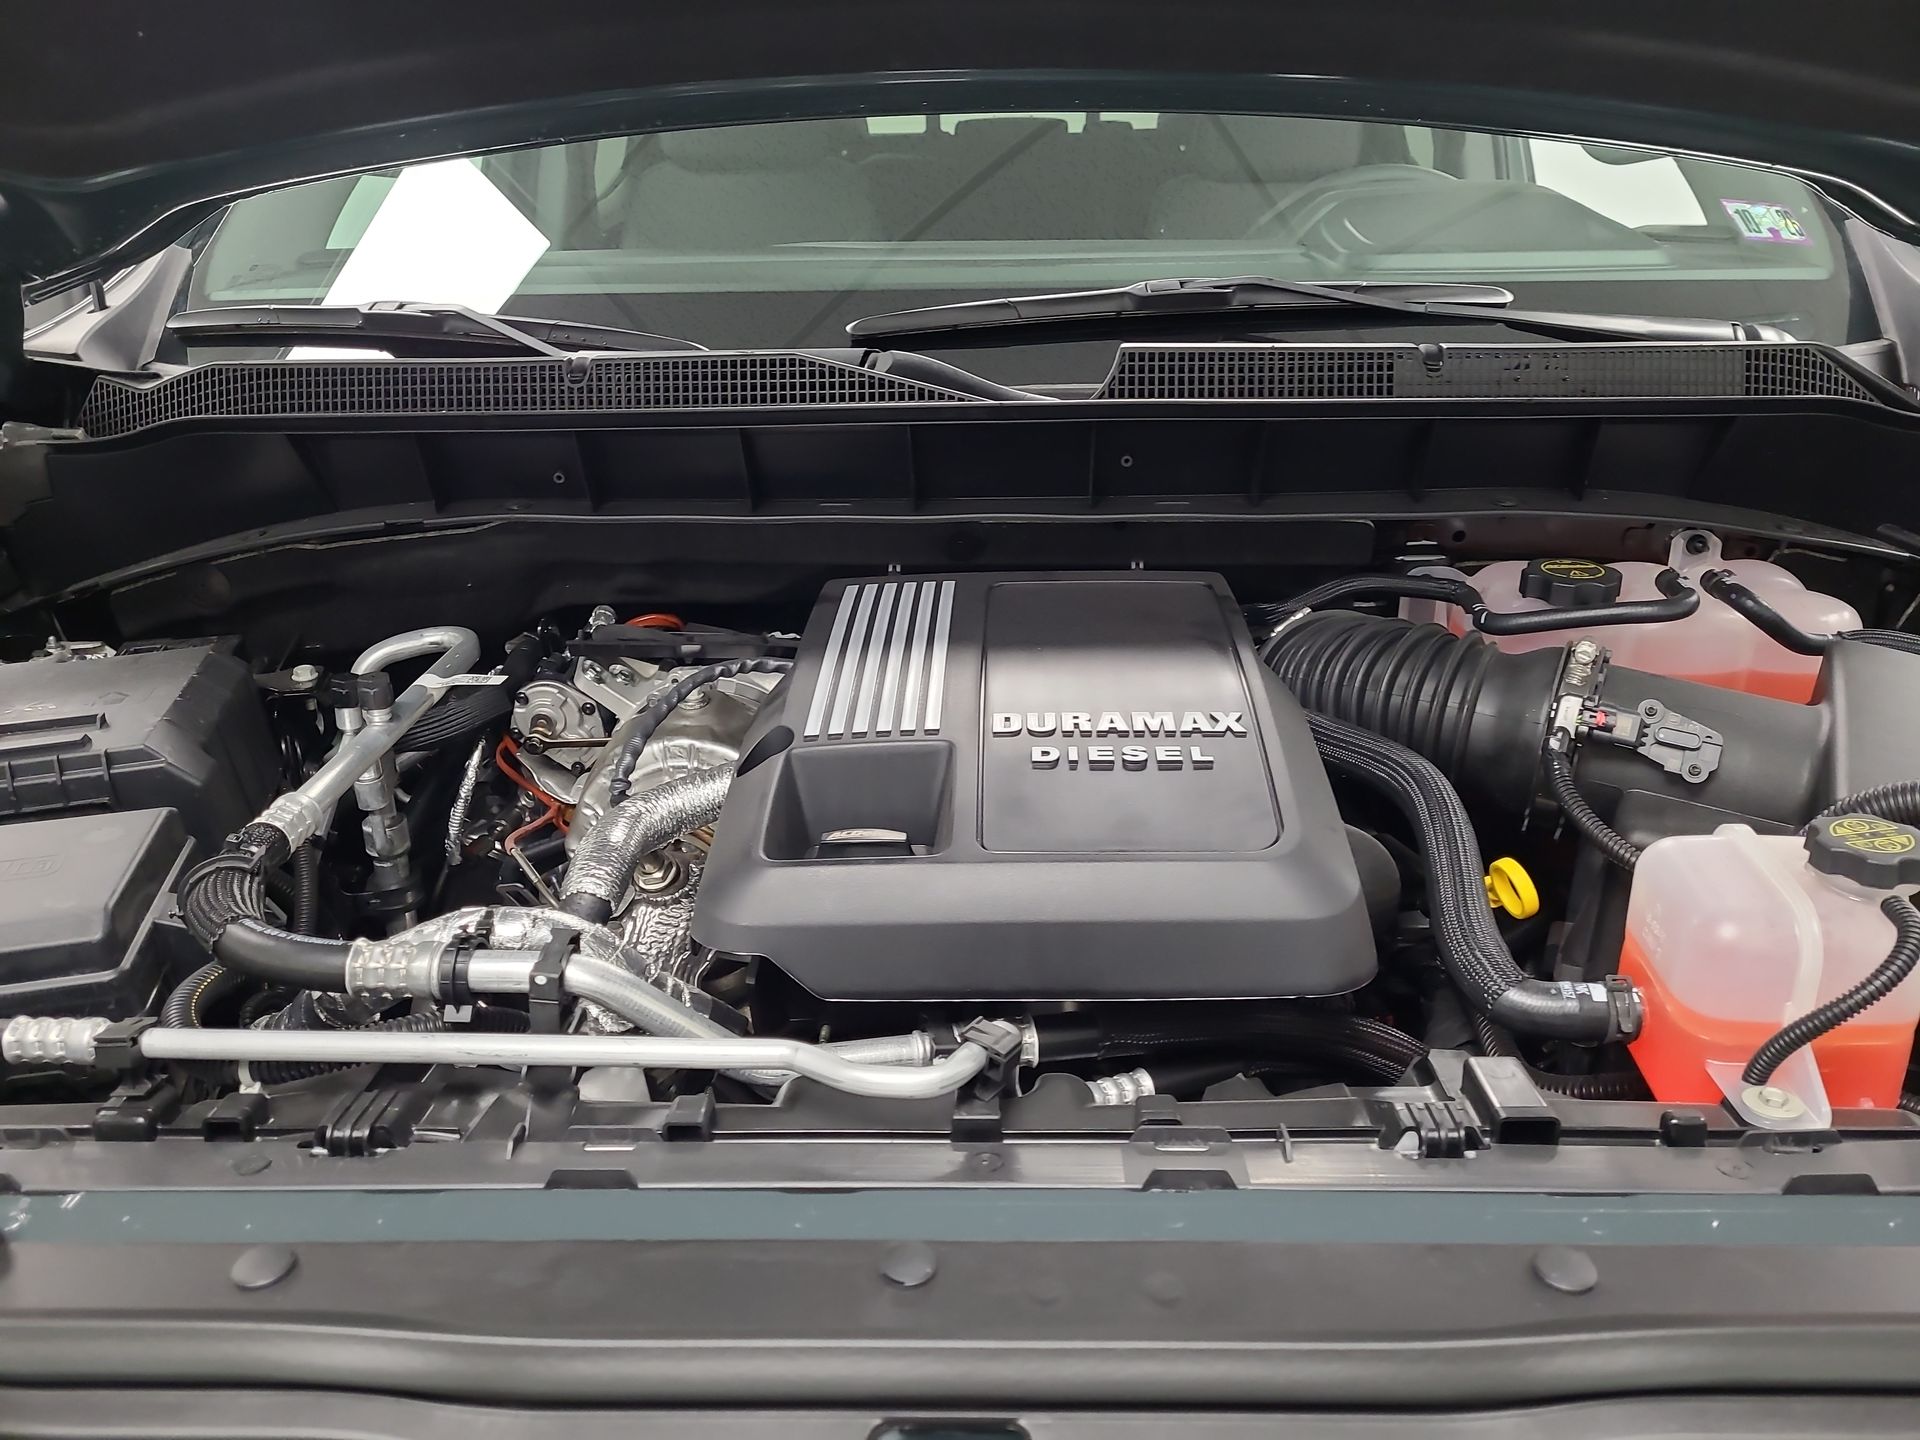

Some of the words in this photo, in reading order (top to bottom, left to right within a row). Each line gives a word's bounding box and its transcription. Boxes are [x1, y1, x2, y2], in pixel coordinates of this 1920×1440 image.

[1734, 208, 1763, 234] 10
[992, 711, 1247, 737] DURAMAX
[1031, 745, 1214, 769] DIESEL
